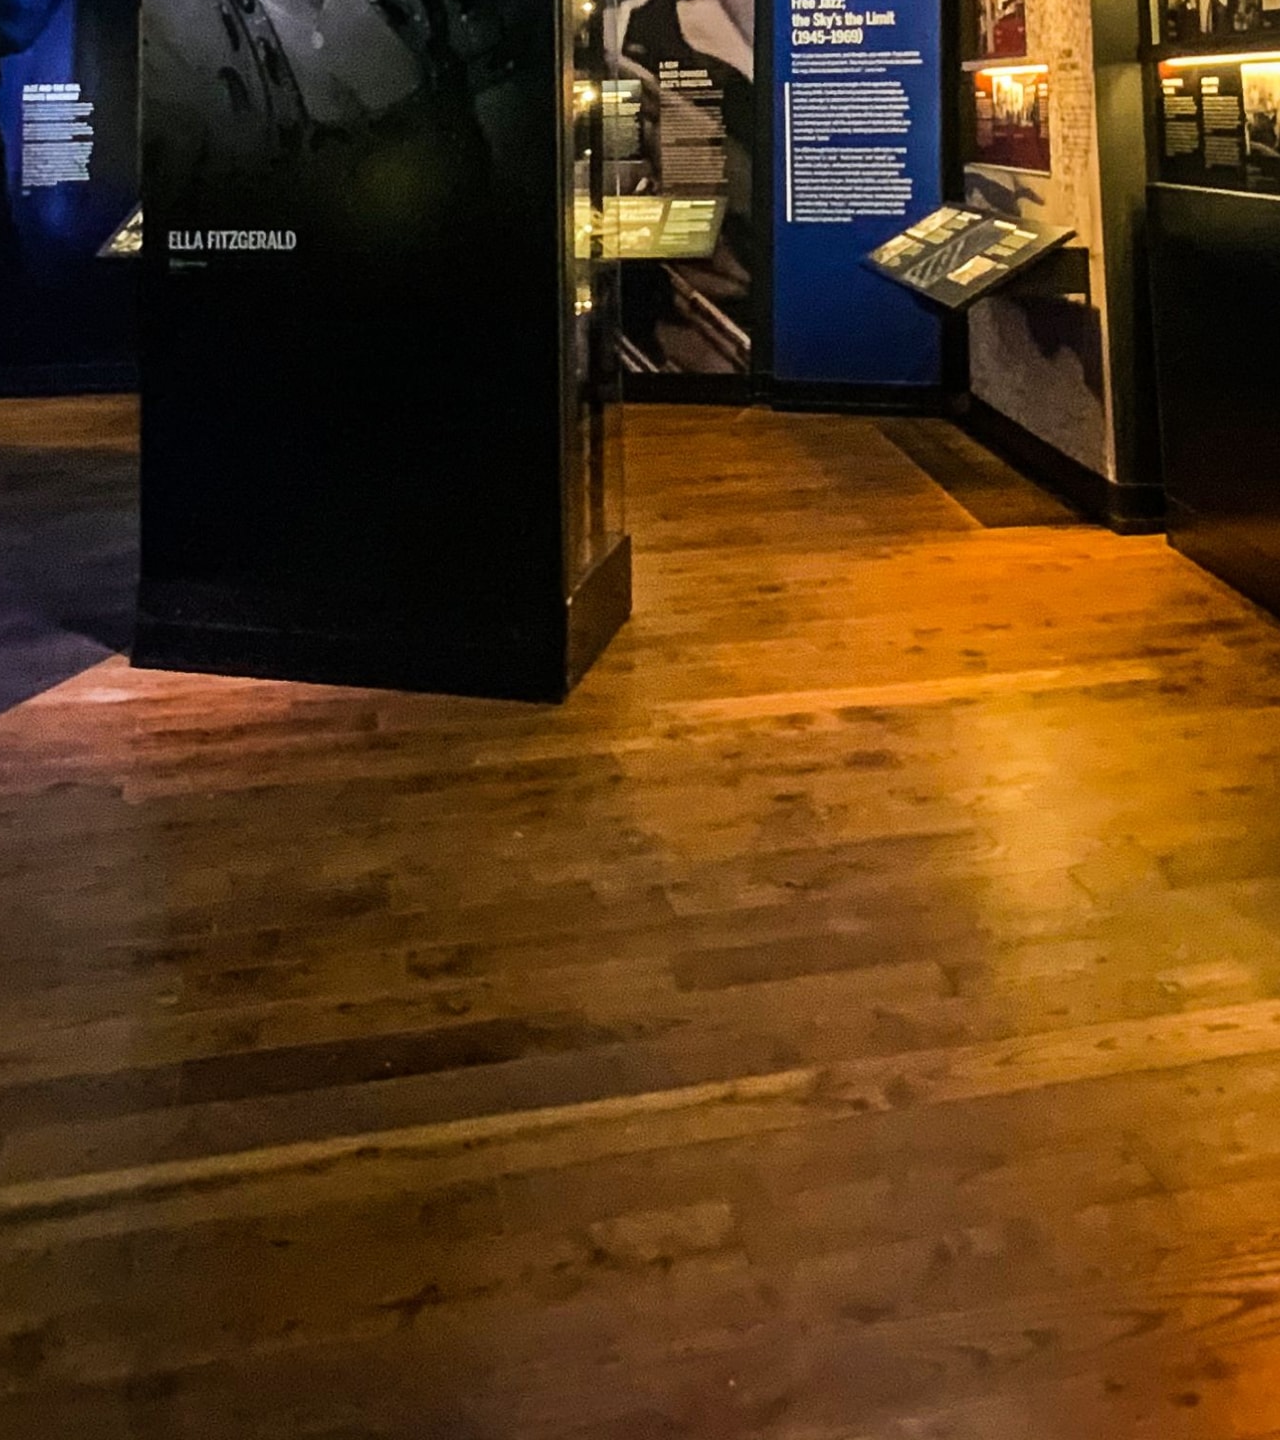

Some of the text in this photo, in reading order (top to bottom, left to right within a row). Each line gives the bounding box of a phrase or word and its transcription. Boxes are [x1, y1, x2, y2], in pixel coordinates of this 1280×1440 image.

[791, 10, 896, 29] the Sky's the Limit
[168, 230, 297, 251] ELLA FITZGERALD
